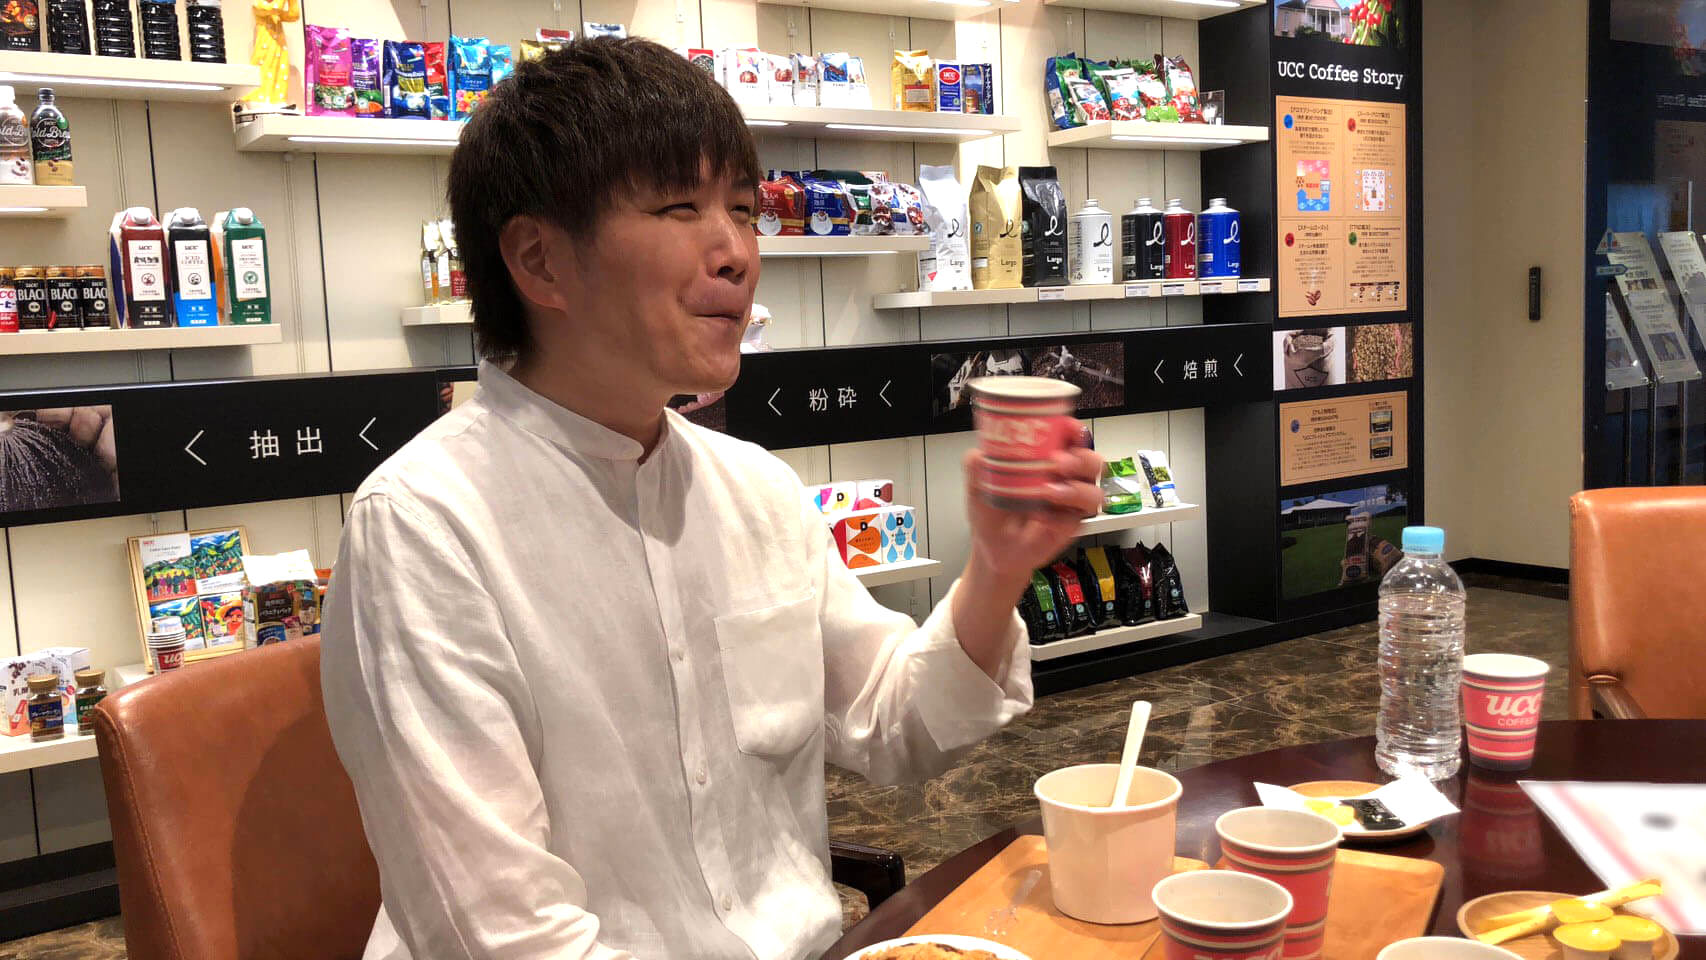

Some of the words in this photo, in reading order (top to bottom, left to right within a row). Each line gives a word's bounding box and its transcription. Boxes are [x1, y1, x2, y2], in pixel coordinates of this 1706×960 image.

[1277, 61, 1304, 78] UCC
[1309, 63, 1359, 82] Coffee
[1363, 67, 1404, 89] Story
[17, 288, 46, 301] BLAC
[50, 288, 78, 301] BLAC
[82, 287, 108, 300] BLAC
[1183, 359, 1218, 380] 焙煎
[808, 386, 857, 412] 粉砕
[249, 426, 323, 459] 抽出
